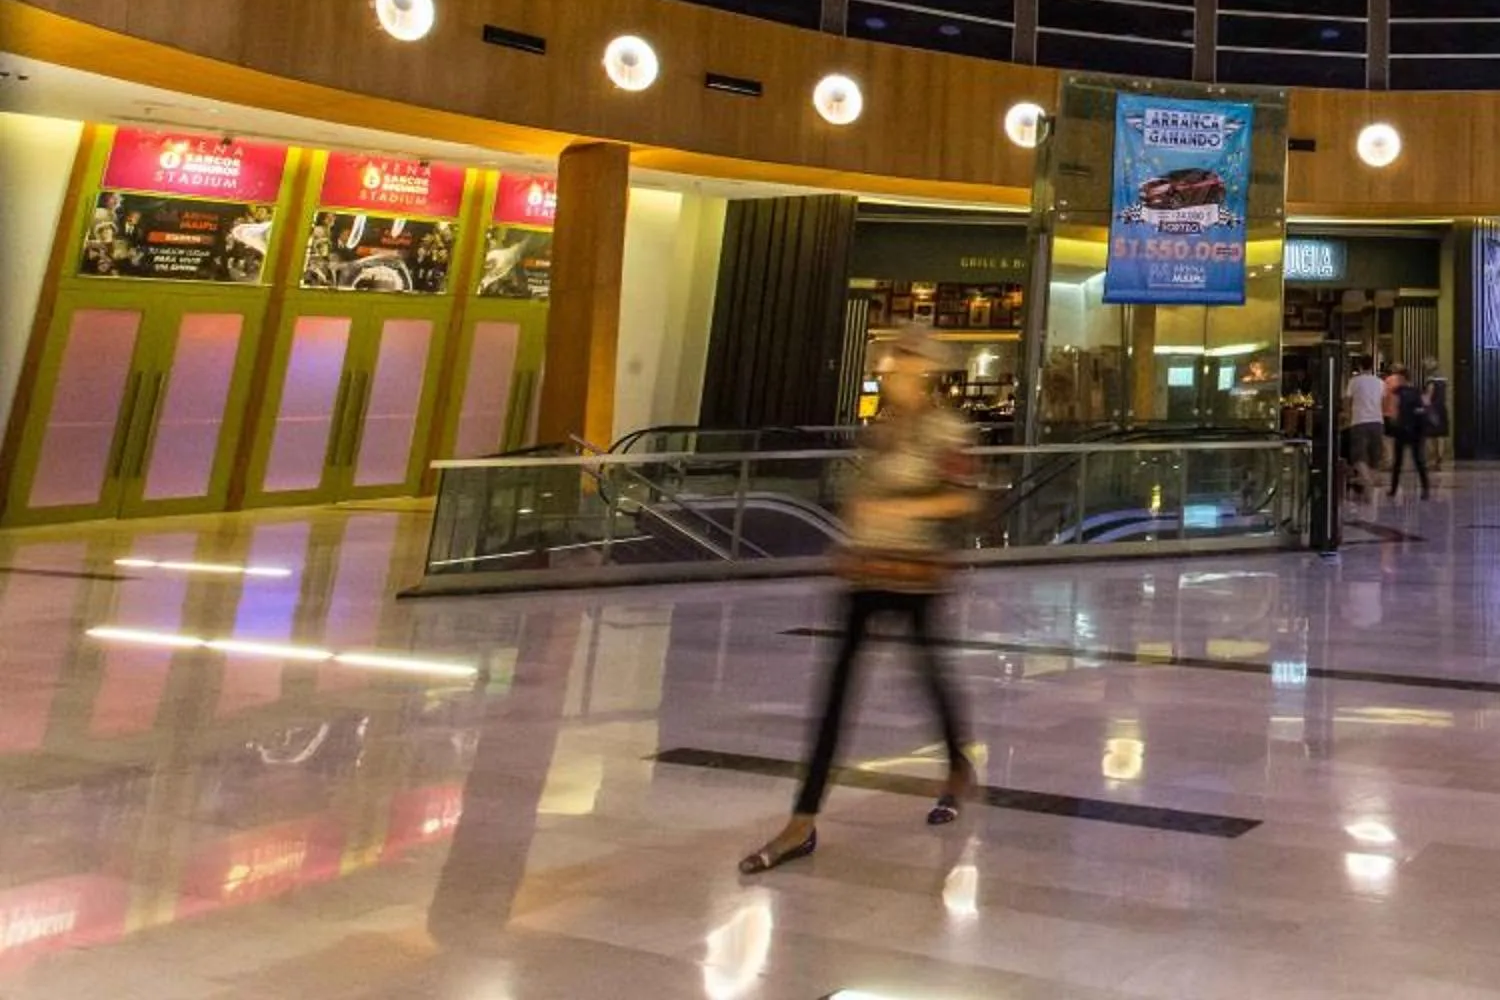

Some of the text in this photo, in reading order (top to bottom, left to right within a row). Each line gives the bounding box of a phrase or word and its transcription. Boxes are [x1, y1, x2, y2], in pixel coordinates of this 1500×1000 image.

[1149, 130, 1222, 147] GANANDO
[153, 169, 239, 189] STADIUM
[359, 188, 427, 205] STADIUM
